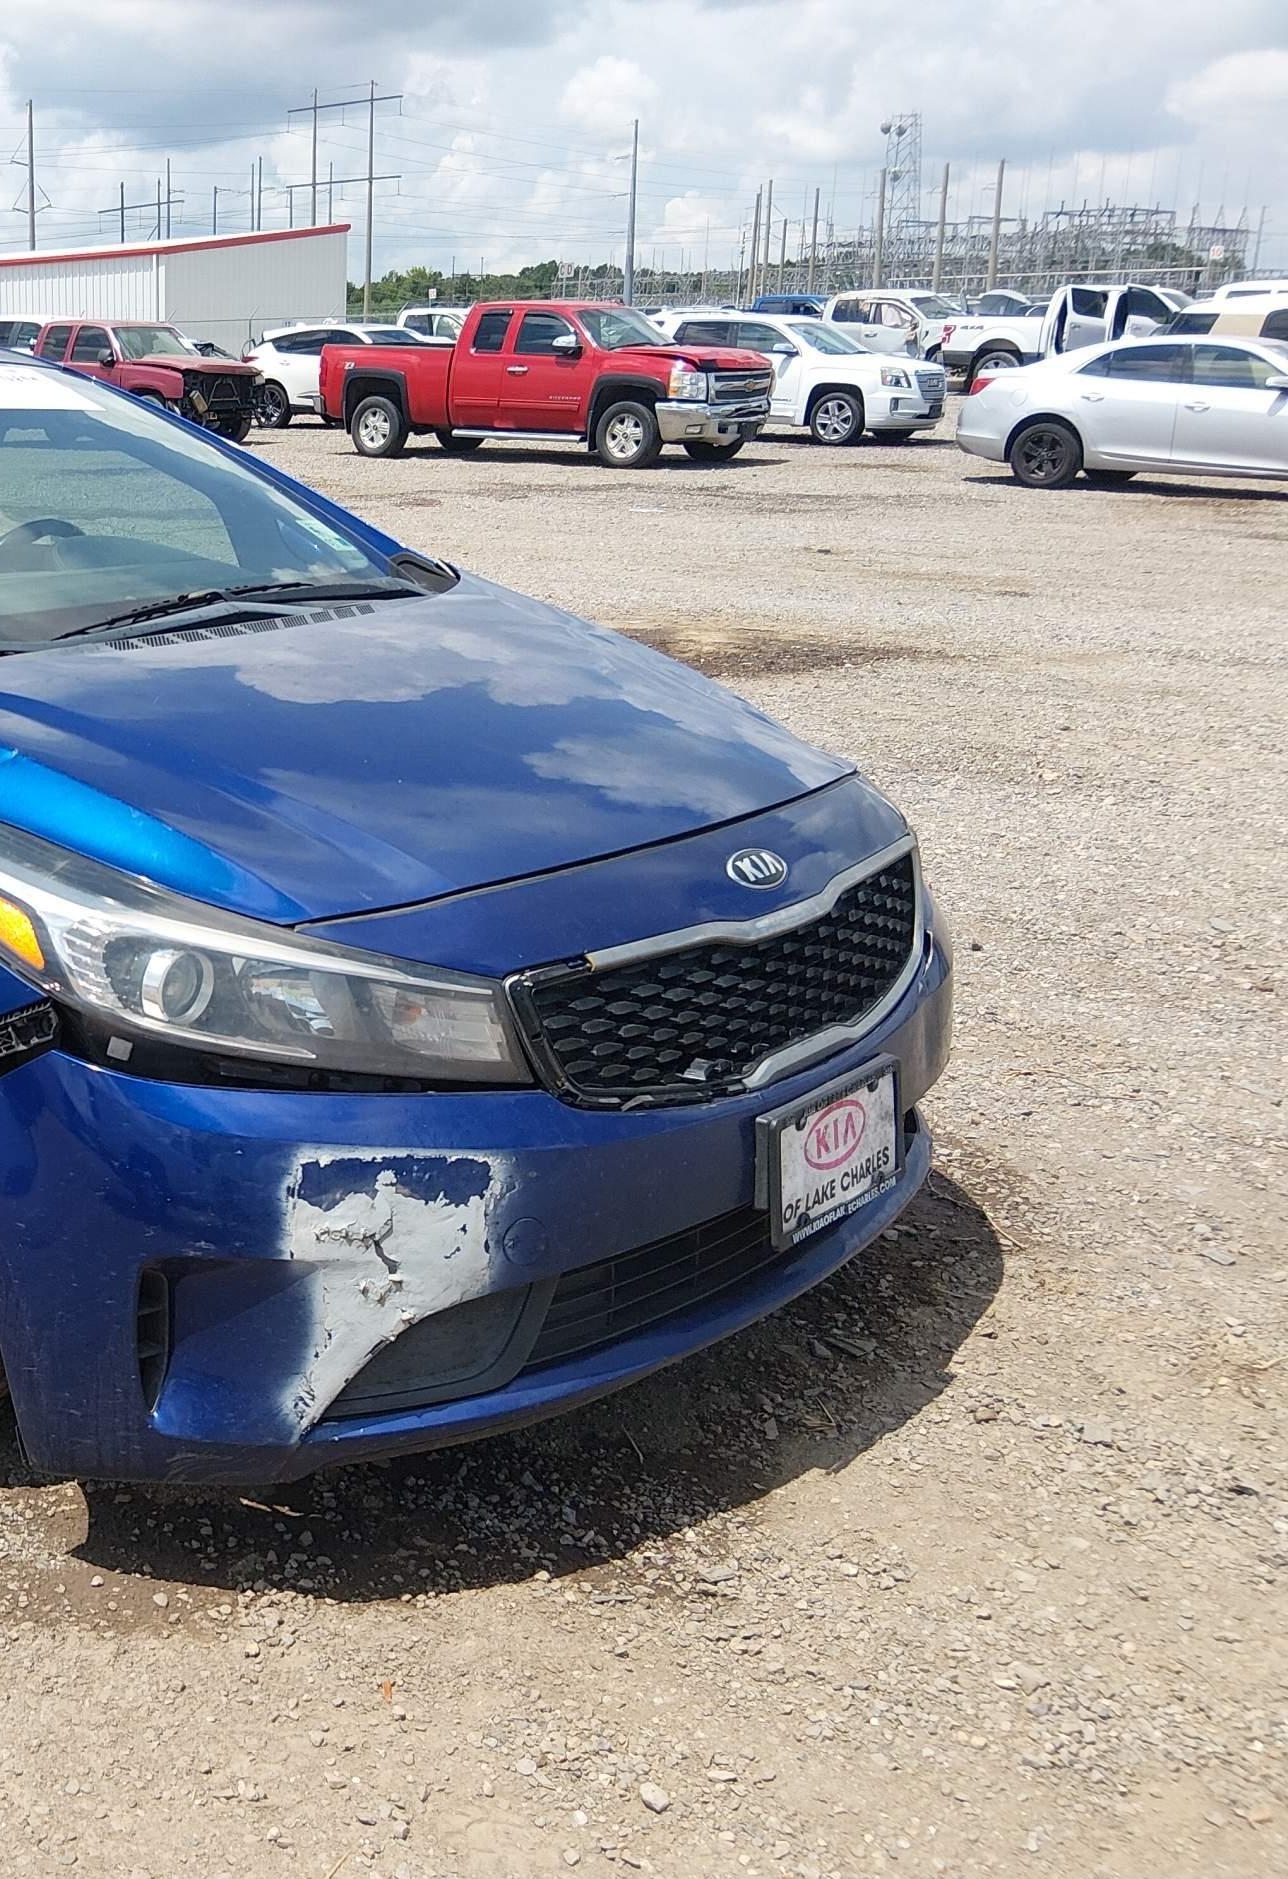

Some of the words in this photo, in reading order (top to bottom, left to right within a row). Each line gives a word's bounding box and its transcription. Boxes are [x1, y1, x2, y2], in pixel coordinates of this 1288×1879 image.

[734, 852, 783, 882] KIA
[815, 1111, 857, 1160] KIA
[784, 1198, 801, 1224] OF
[805, 1178, 836, 1212] LAKE
[840, 1146, 890, 1192] CHARLES
